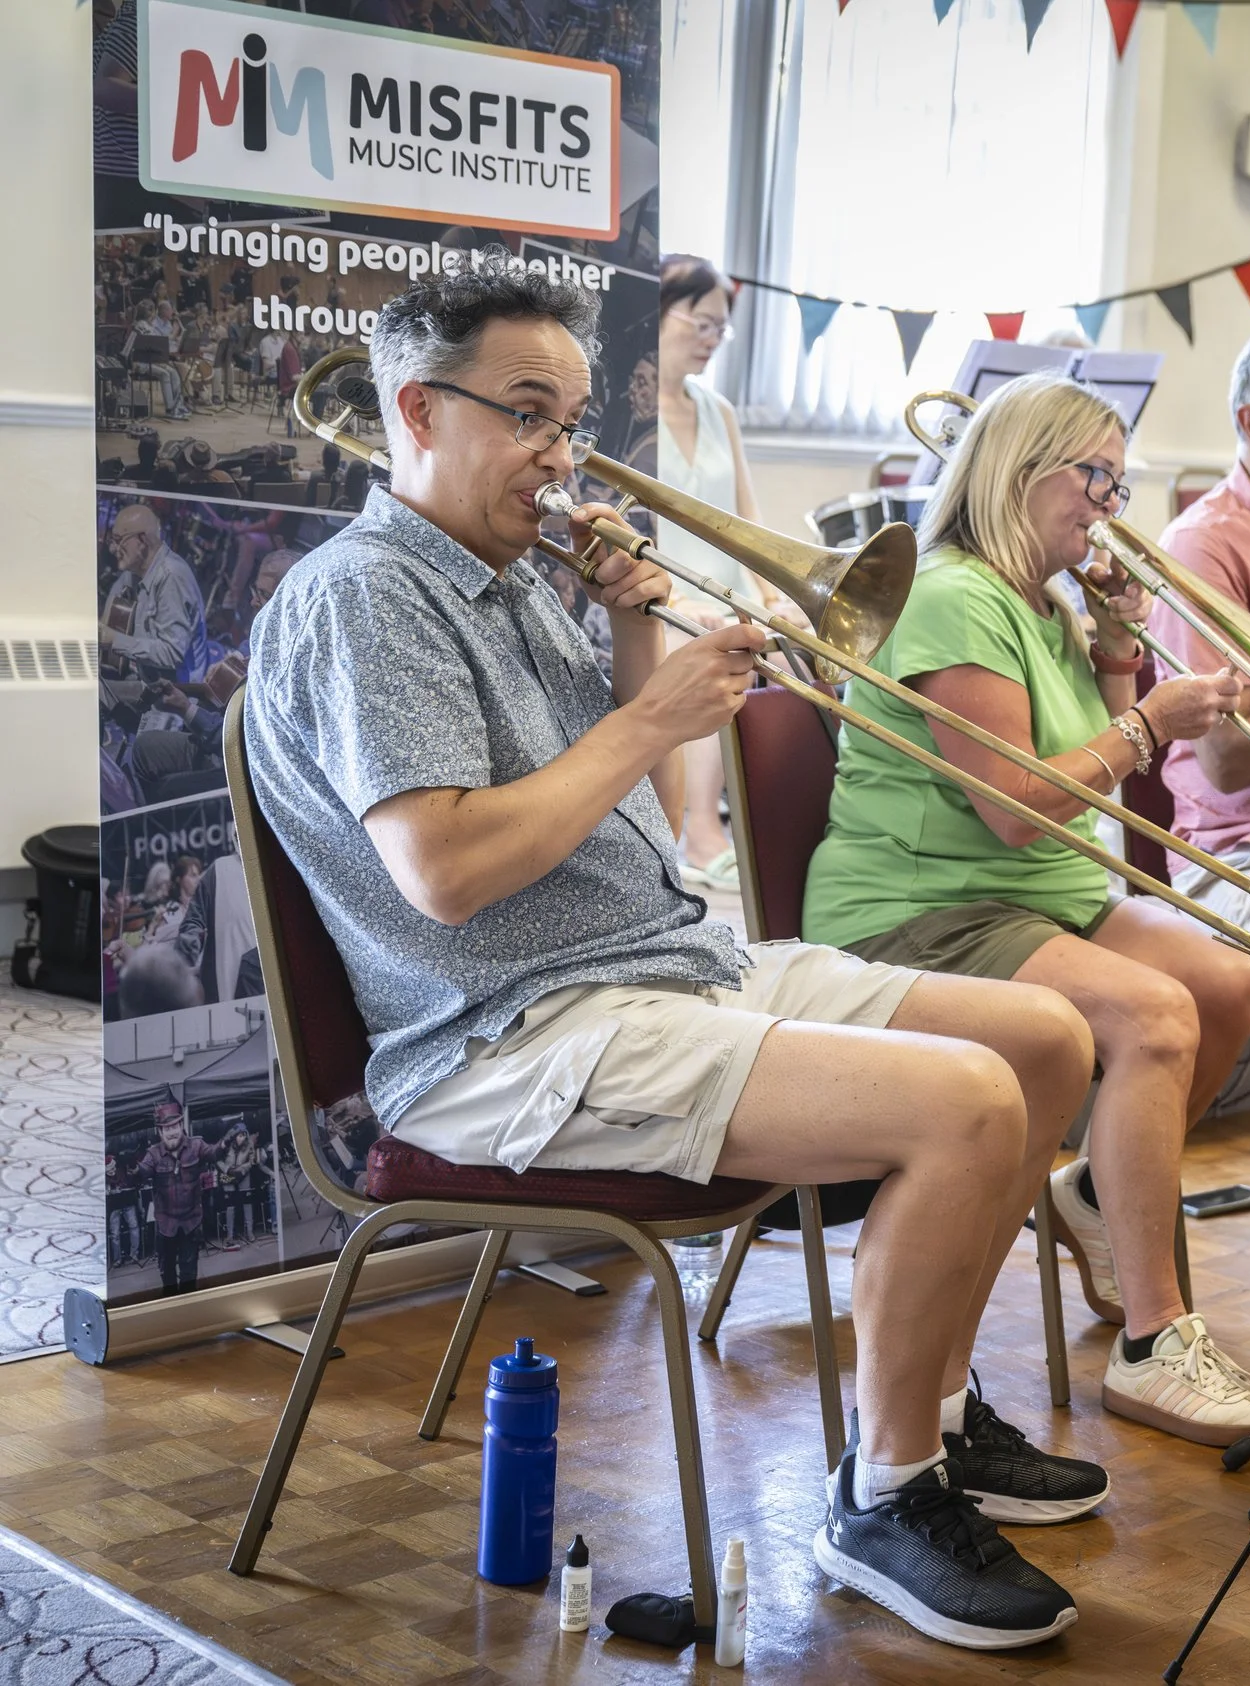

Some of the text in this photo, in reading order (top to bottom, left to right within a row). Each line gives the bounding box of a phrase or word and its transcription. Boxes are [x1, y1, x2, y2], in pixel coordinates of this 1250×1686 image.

[350, 73, 590, 158] MISFITS
[350, 137, 592, 193] MUSIC INSTITUTE
[339, 240, 461, 281] people
[470, 248, 616, 291] tgether
[253, 295, 384, 345] throug
